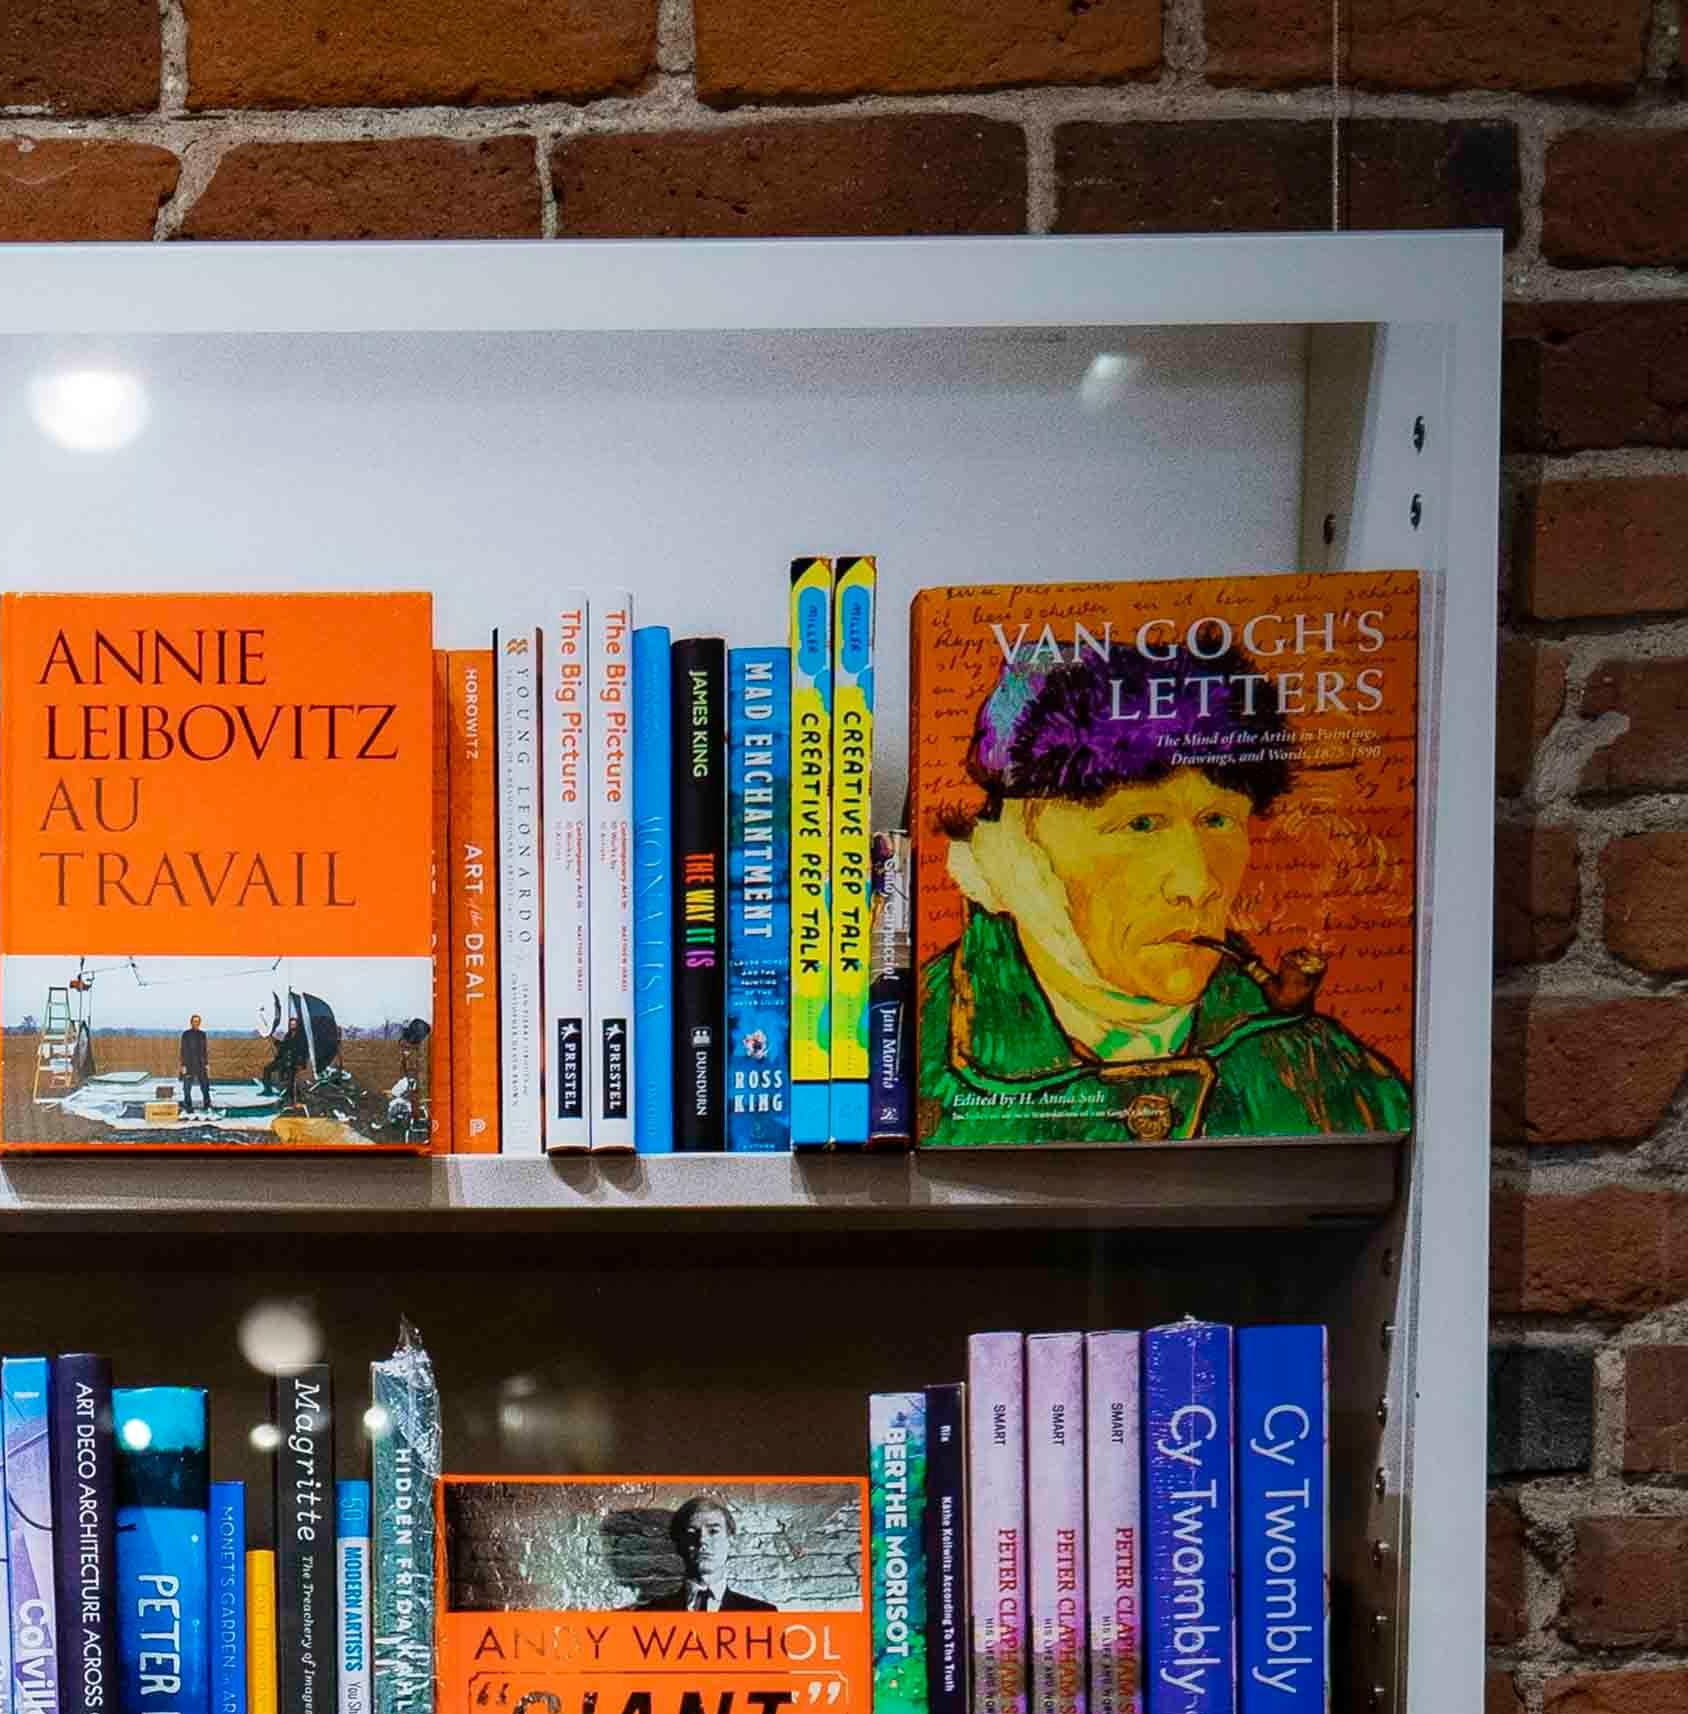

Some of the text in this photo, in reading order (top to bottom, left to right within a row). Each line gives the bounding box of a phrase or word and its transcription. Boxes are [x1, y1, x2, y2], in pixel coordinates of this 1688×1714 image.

[40, 629, 266, 686] ANNIE
[990, 611, 1388, 665] VAN GOGH'S
[44, 704, 399, 761] LEIBOVITZ
[556, 609, 582, 801] The Big Picture
[690, 670, 709, 778] JAMES KING
[1110, 669, 1388, 721] LETTERS
[40, 778, 144, 832] AU
[744, 662, 773, 938] MAD ENCHANTMENT
[800, 713, 823, 973] CREATIVE PEP TALK
[40, 851, 357, 907] TRAVAIL
[686, 853, 714, 968] THE WAY IT IS
[288, 1379, 322, 1541] Magritte
[884, 1429, 909, 1656] BERTHE MORISOT
[1250, 1404, 1313, 1694] Cy Twombly
[137, 1574, 181, 1694] PETER
[474, 1625, 843, 1661] ANDY WARHOL
